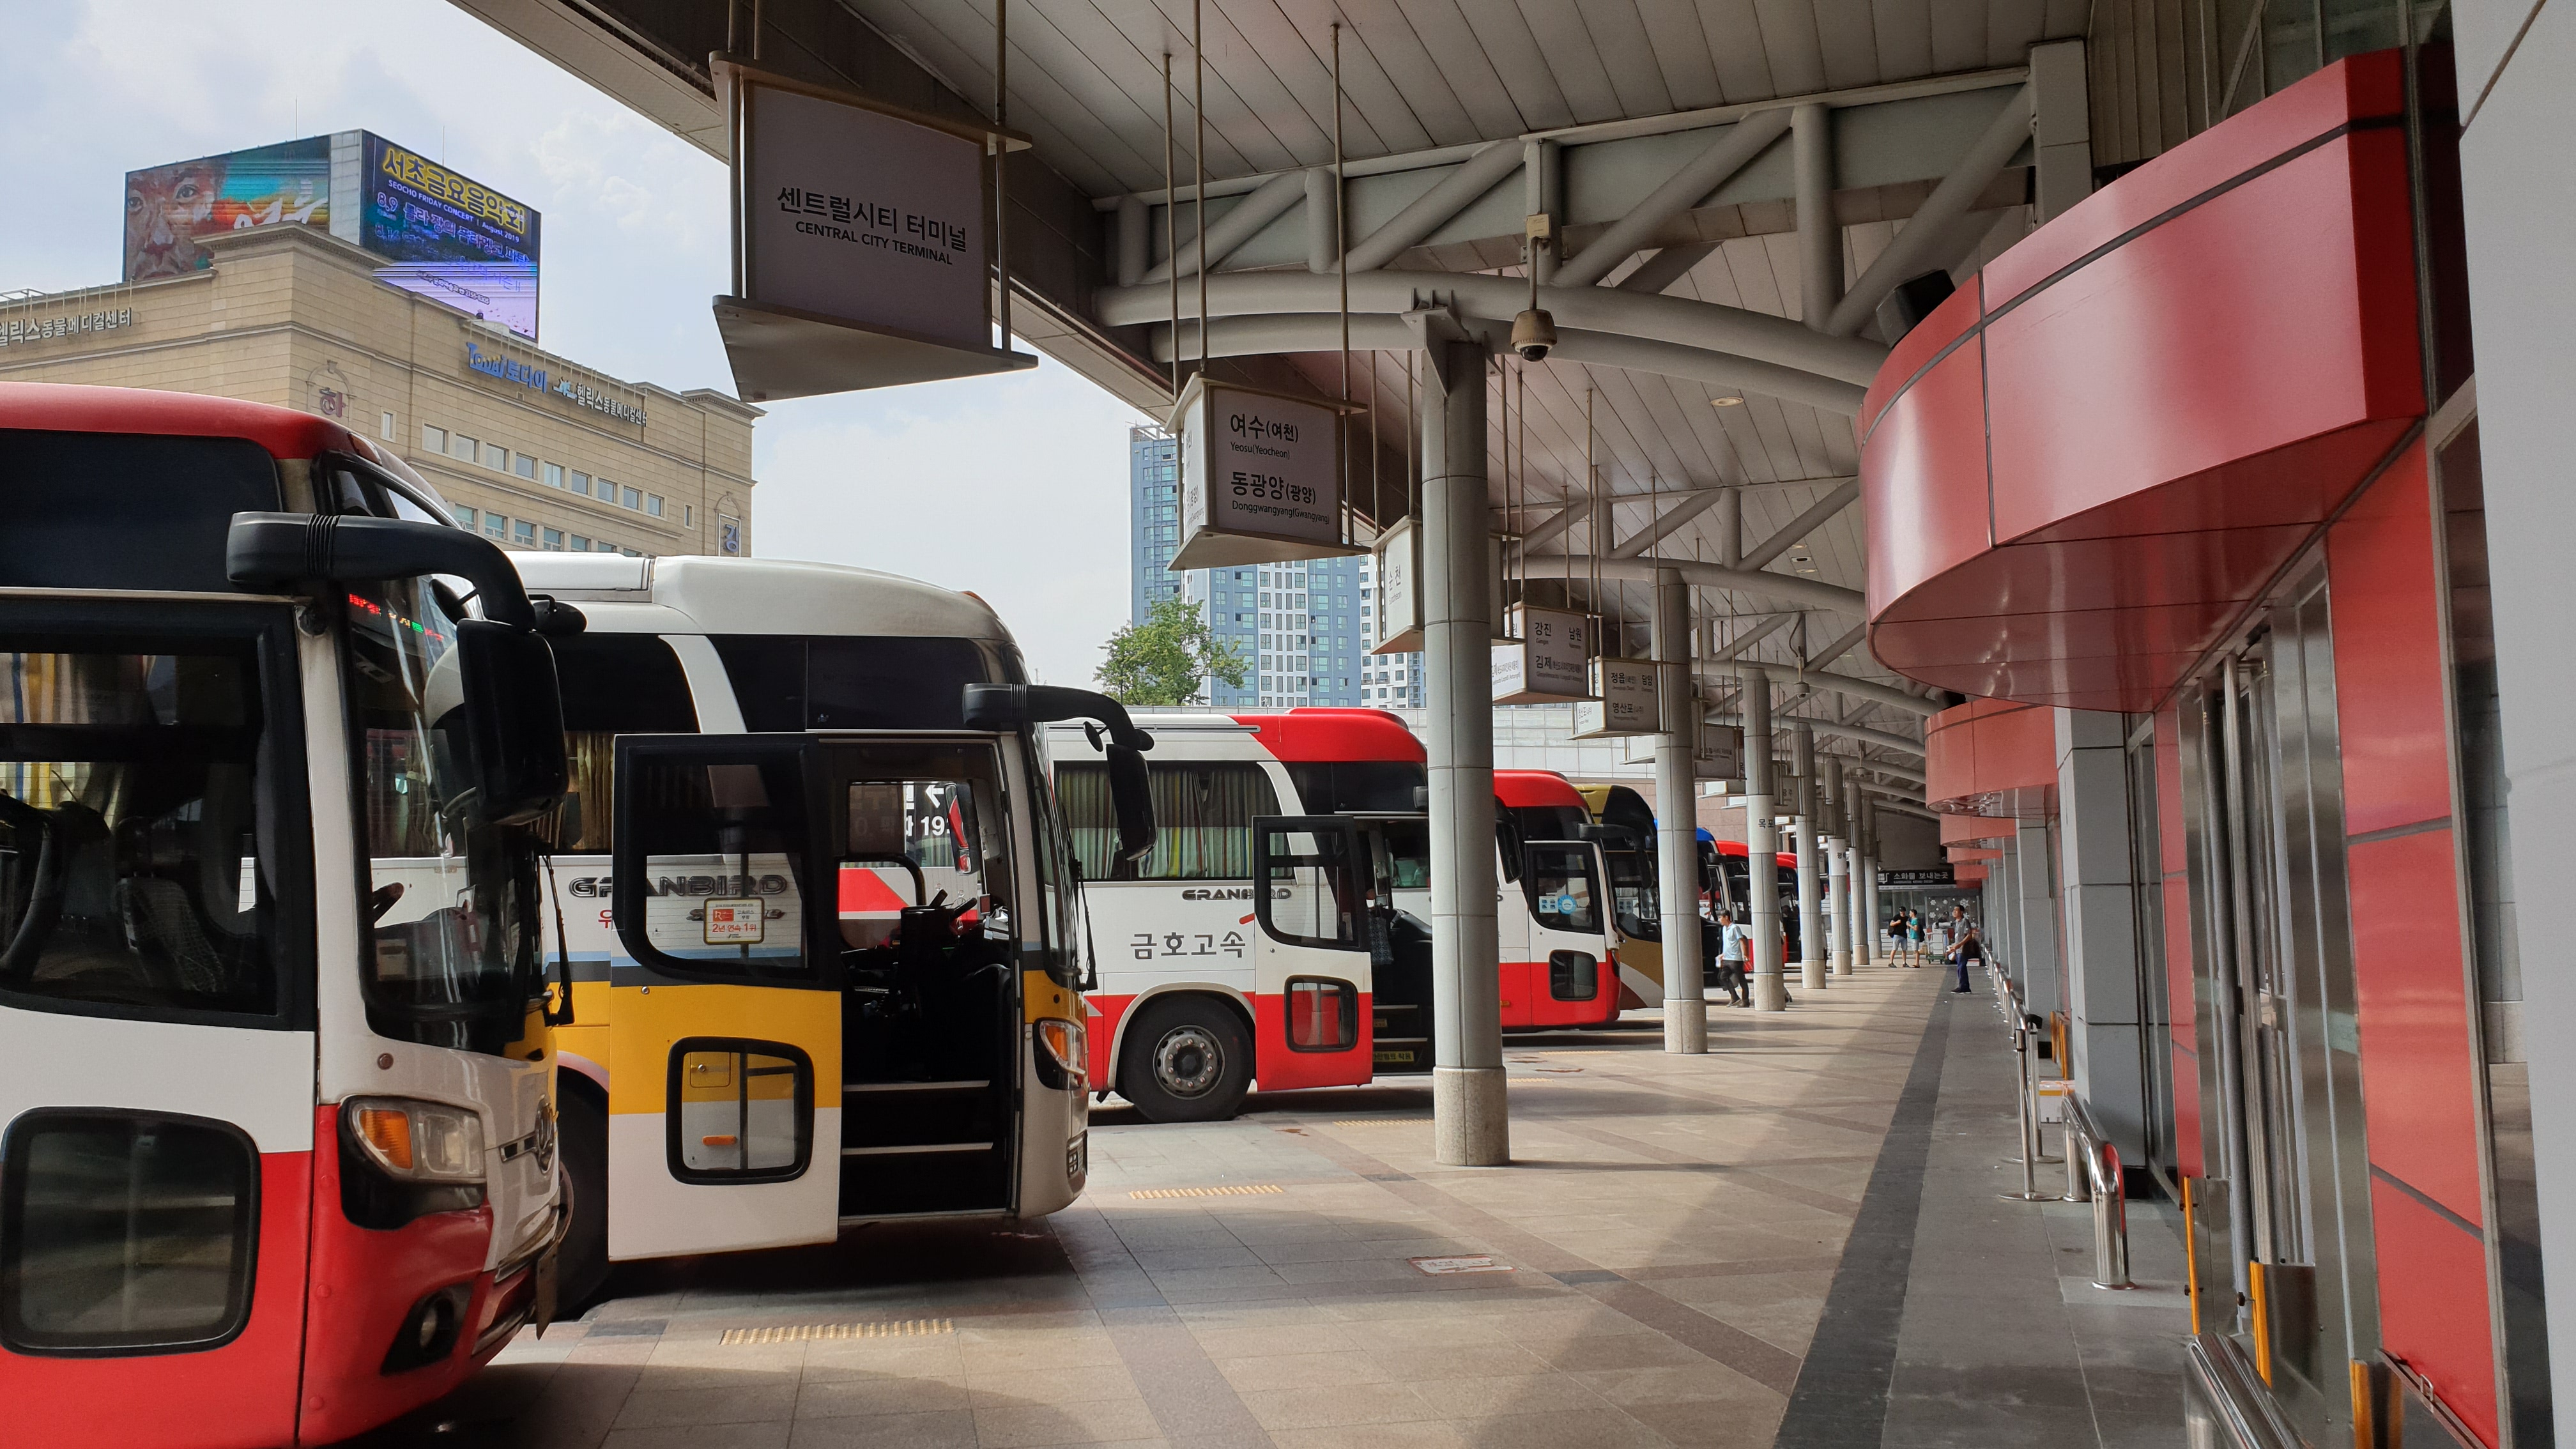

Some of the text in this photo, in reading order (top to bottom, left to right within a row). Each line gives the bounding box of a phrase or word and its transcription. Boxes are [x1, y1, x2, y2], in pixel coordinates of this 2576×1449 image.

[377, 192, 399, 212] 8.9
[385, 149, 524, 233] 서초금요음악회
[388, 180, 519, 243] SEOCHO FRIDAY CONCERT August 2019
[777, 187, 967, 253] 센트럴시티 터미널
[795, 220, 953, 266] CENTRAL CITY TERMINAL
[505, 358, 548, 394] 토다이
[576, 382, 647, 427] 헬릭스동물메디컬센터
[1230, 413, 1300, 443] 여수(여천)
[1230, 441, 1291, 460] Yeosu(Yeocheon)
[1230, 471, 1316, 505] 동광양(광양)
[1232, 500, 1330, 525] Donggwangyang(Gwangyang)
[1388, 564, 1401, 592] 순천
[1535, 622, 1551, 636] 강진
[1568, 626, 1582, 641] 남원
[569, 875, 788, 898] GNBIRD
[1893, 872, 1915, 880] 소화물
[1182, 888, 1291, 901] GRANBD
[712, 923, 757, 932] 2년 연속 1위
[1130, 931, 1246, 960] 금호고속
